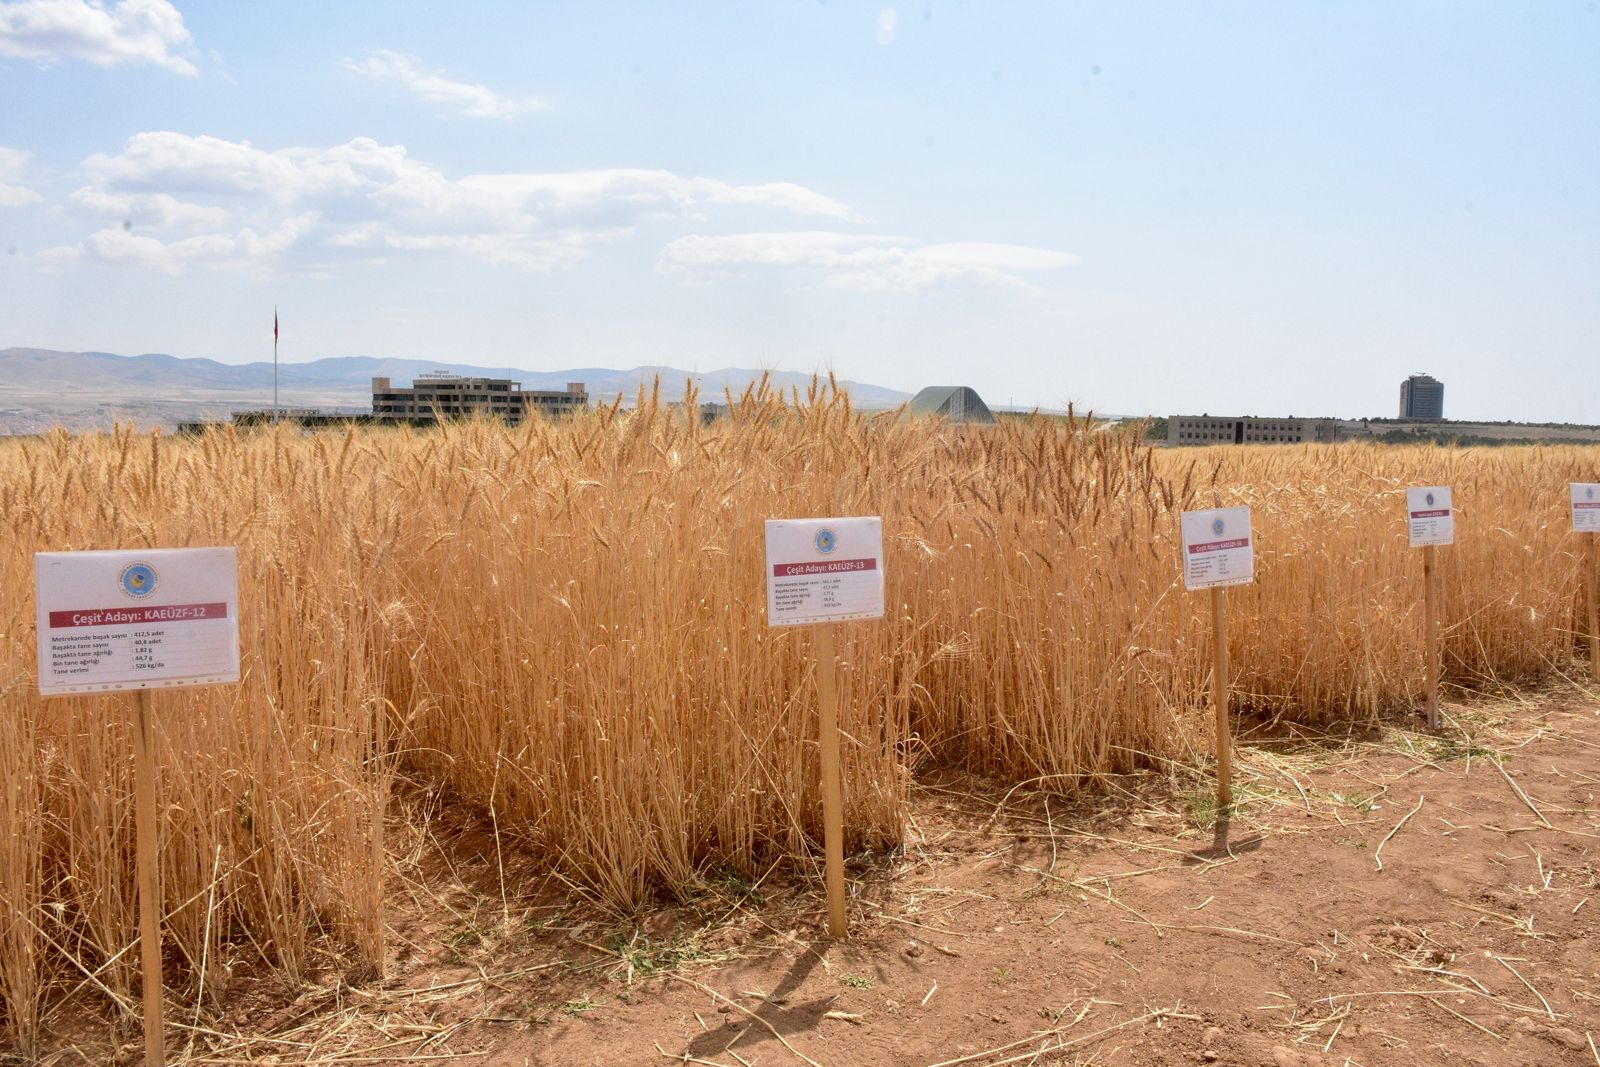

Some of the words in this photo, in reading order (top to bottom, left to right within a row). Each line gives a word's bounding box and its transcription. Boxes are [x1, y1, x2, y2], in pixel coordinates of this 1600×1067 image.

[787, 566, 804, 575] Çeşit
[806, 565, 827, 573] Adayı:
[829, 562, 864, 571] KAEÜZF-13
[73, 613, 101, 625] Çeşit
[105, 611, 142, 622] Adayı:
[144, 607, 206, 619] KAEÜZF-12
